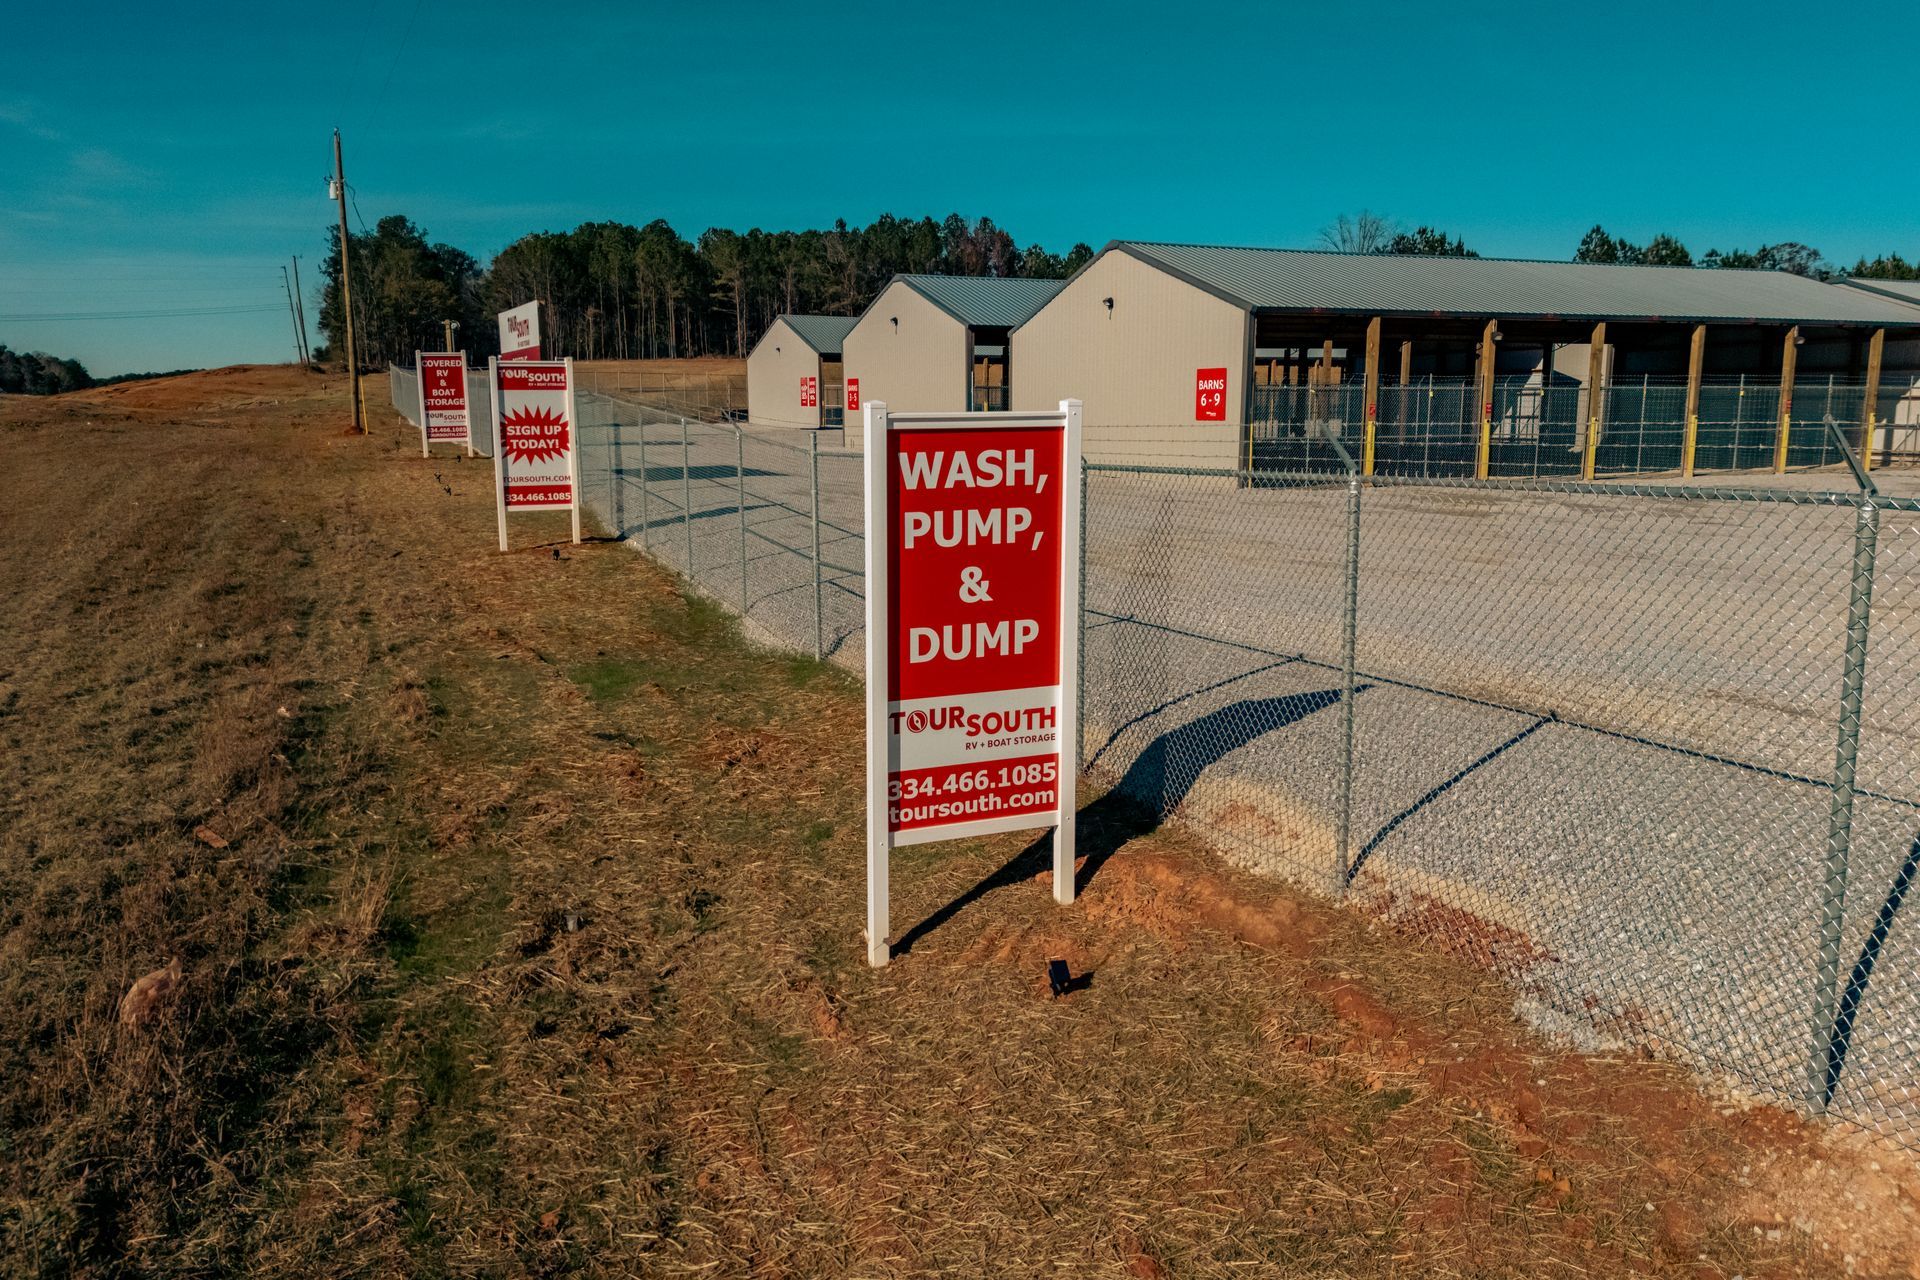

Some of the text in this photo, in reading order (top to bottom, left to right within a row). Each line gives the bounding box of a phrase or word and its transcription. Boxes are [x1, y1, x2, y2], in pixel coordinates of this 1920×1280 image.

[436, 369, 448, 377] RV
[1198, 379, 1224, 390] BARNS
[425, 398, 465, 406] STORAGE
[507, 425, 562, 436] SIGN UP
[510, 438, 559, 449] TODAY!
[898, 449, 1049, 494] WASH,
[503, 475, 571, 483] TOURSOUTH.COM
[505, 492, 571, 502] 334.466.1085
[904, 507, 1045, 551] PUMP,
[958, 566, 994, 603] &
[909, 619, 1040, 664] DUMP
[965, 742, 978, 750] RV
[987, 738, 1012, 748] BOAT
[1013, 733, 1056, 745] STORAGE
[889, 762, 1056, 800] 334.466.1085
[889, 789, 1055, 824] toursouth.com
